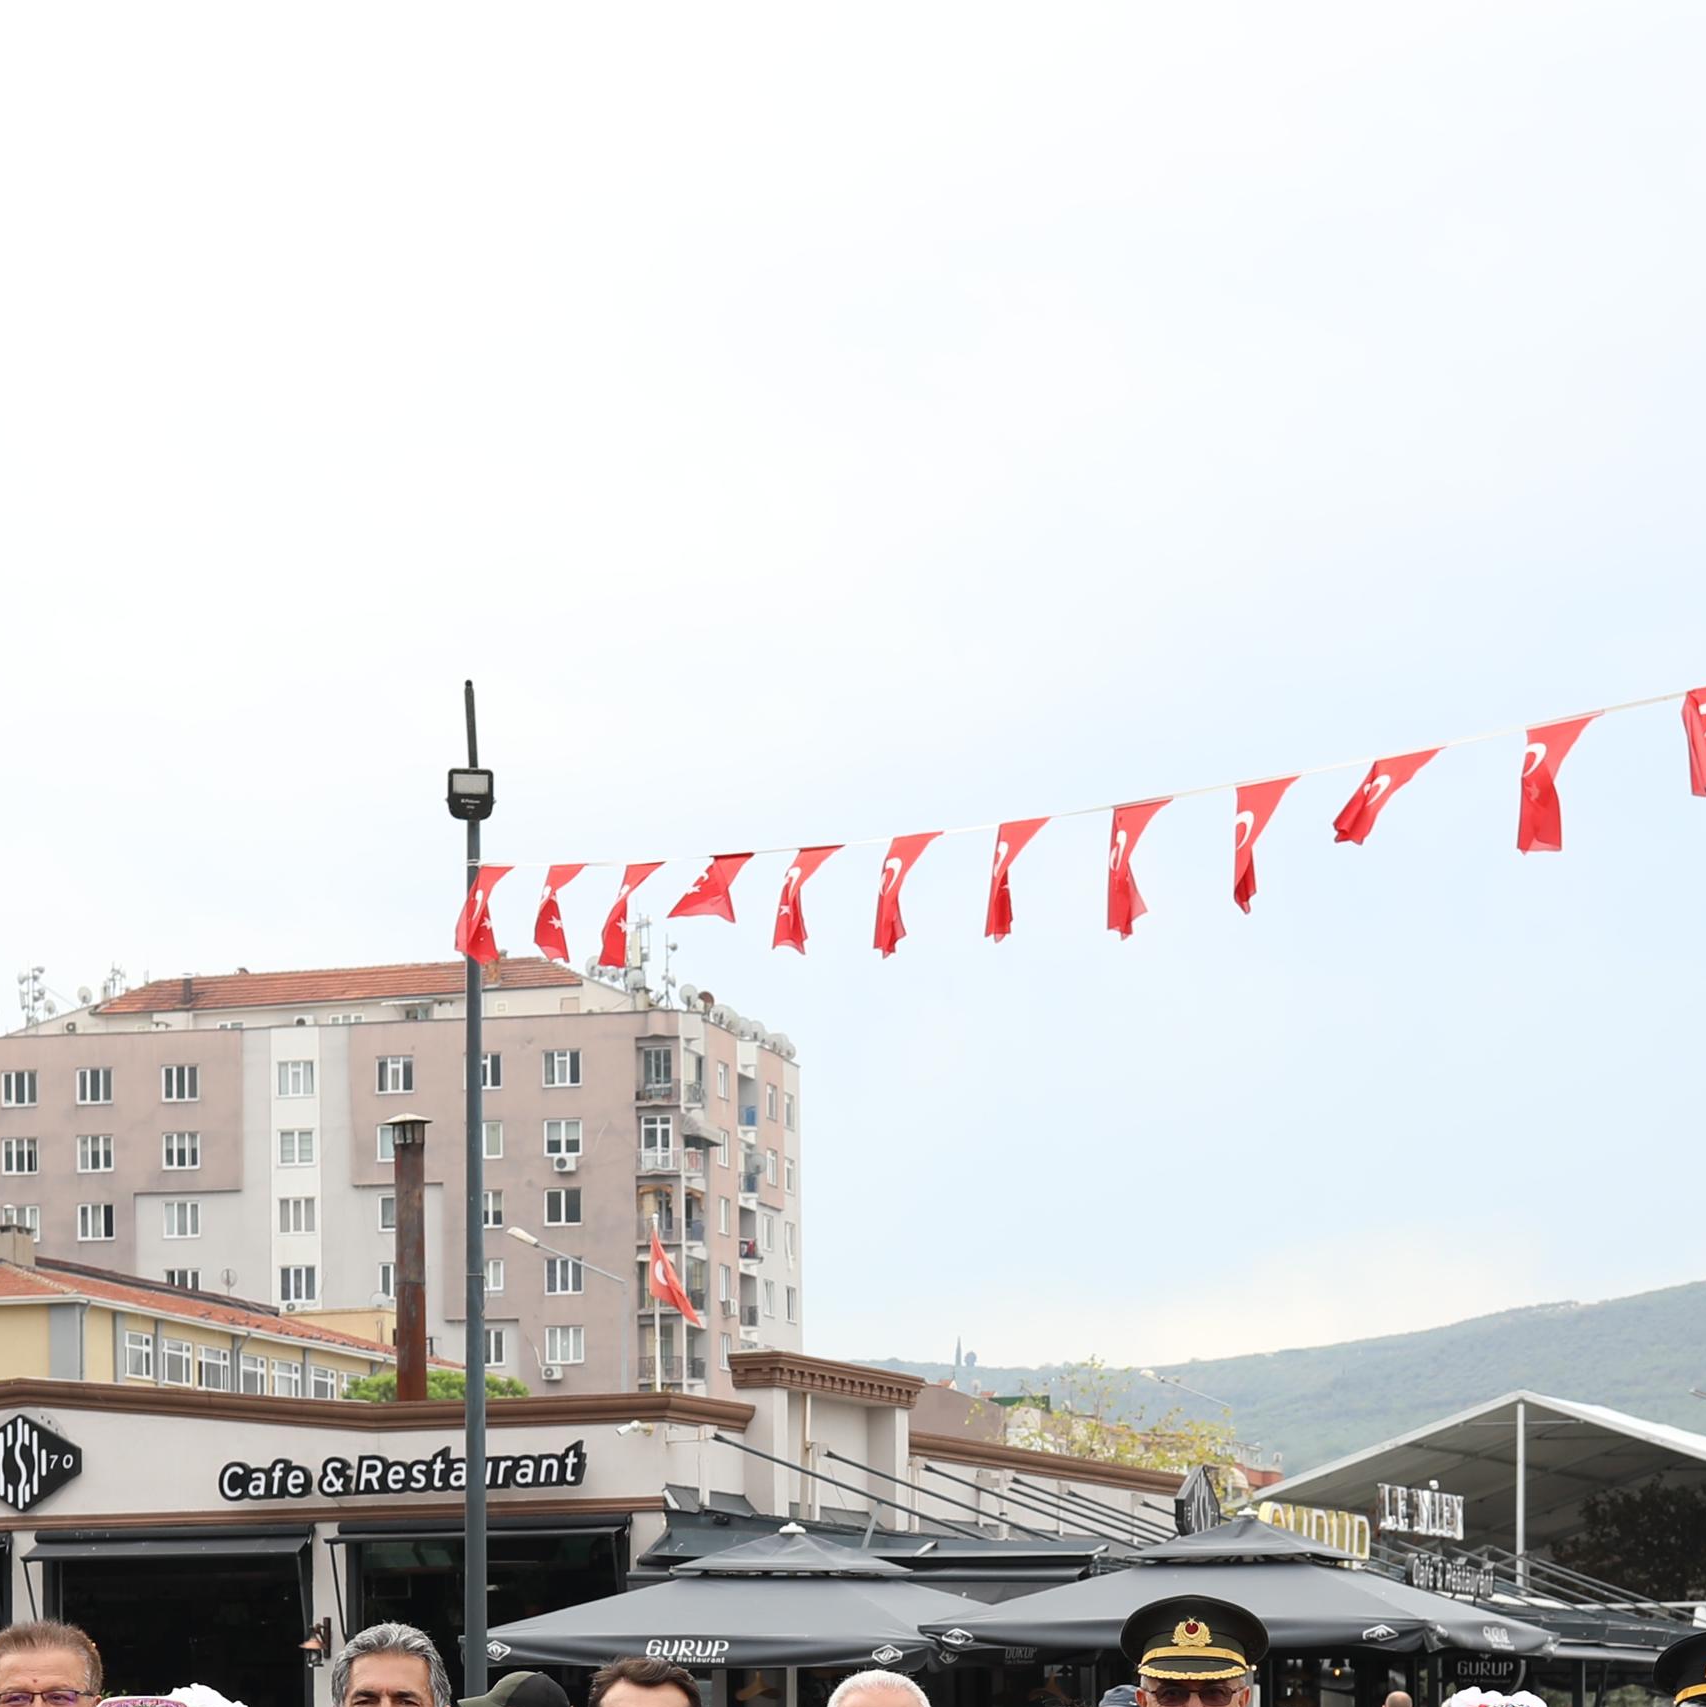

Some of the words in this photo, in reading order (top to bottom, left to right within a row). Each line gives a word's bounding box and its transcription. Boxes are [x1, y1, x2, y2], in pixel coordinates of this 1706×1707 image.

[49, 1454, 73, 1469] 70
[222, 1463, 305, 1498] Cafe
[322, 1461, 344, 1494] &
[359, 1450, 579, 1491] Restarant
[645, 1639, 729, 1657] GURUP
[1457, 1661, 1514, 1676] GURUP
